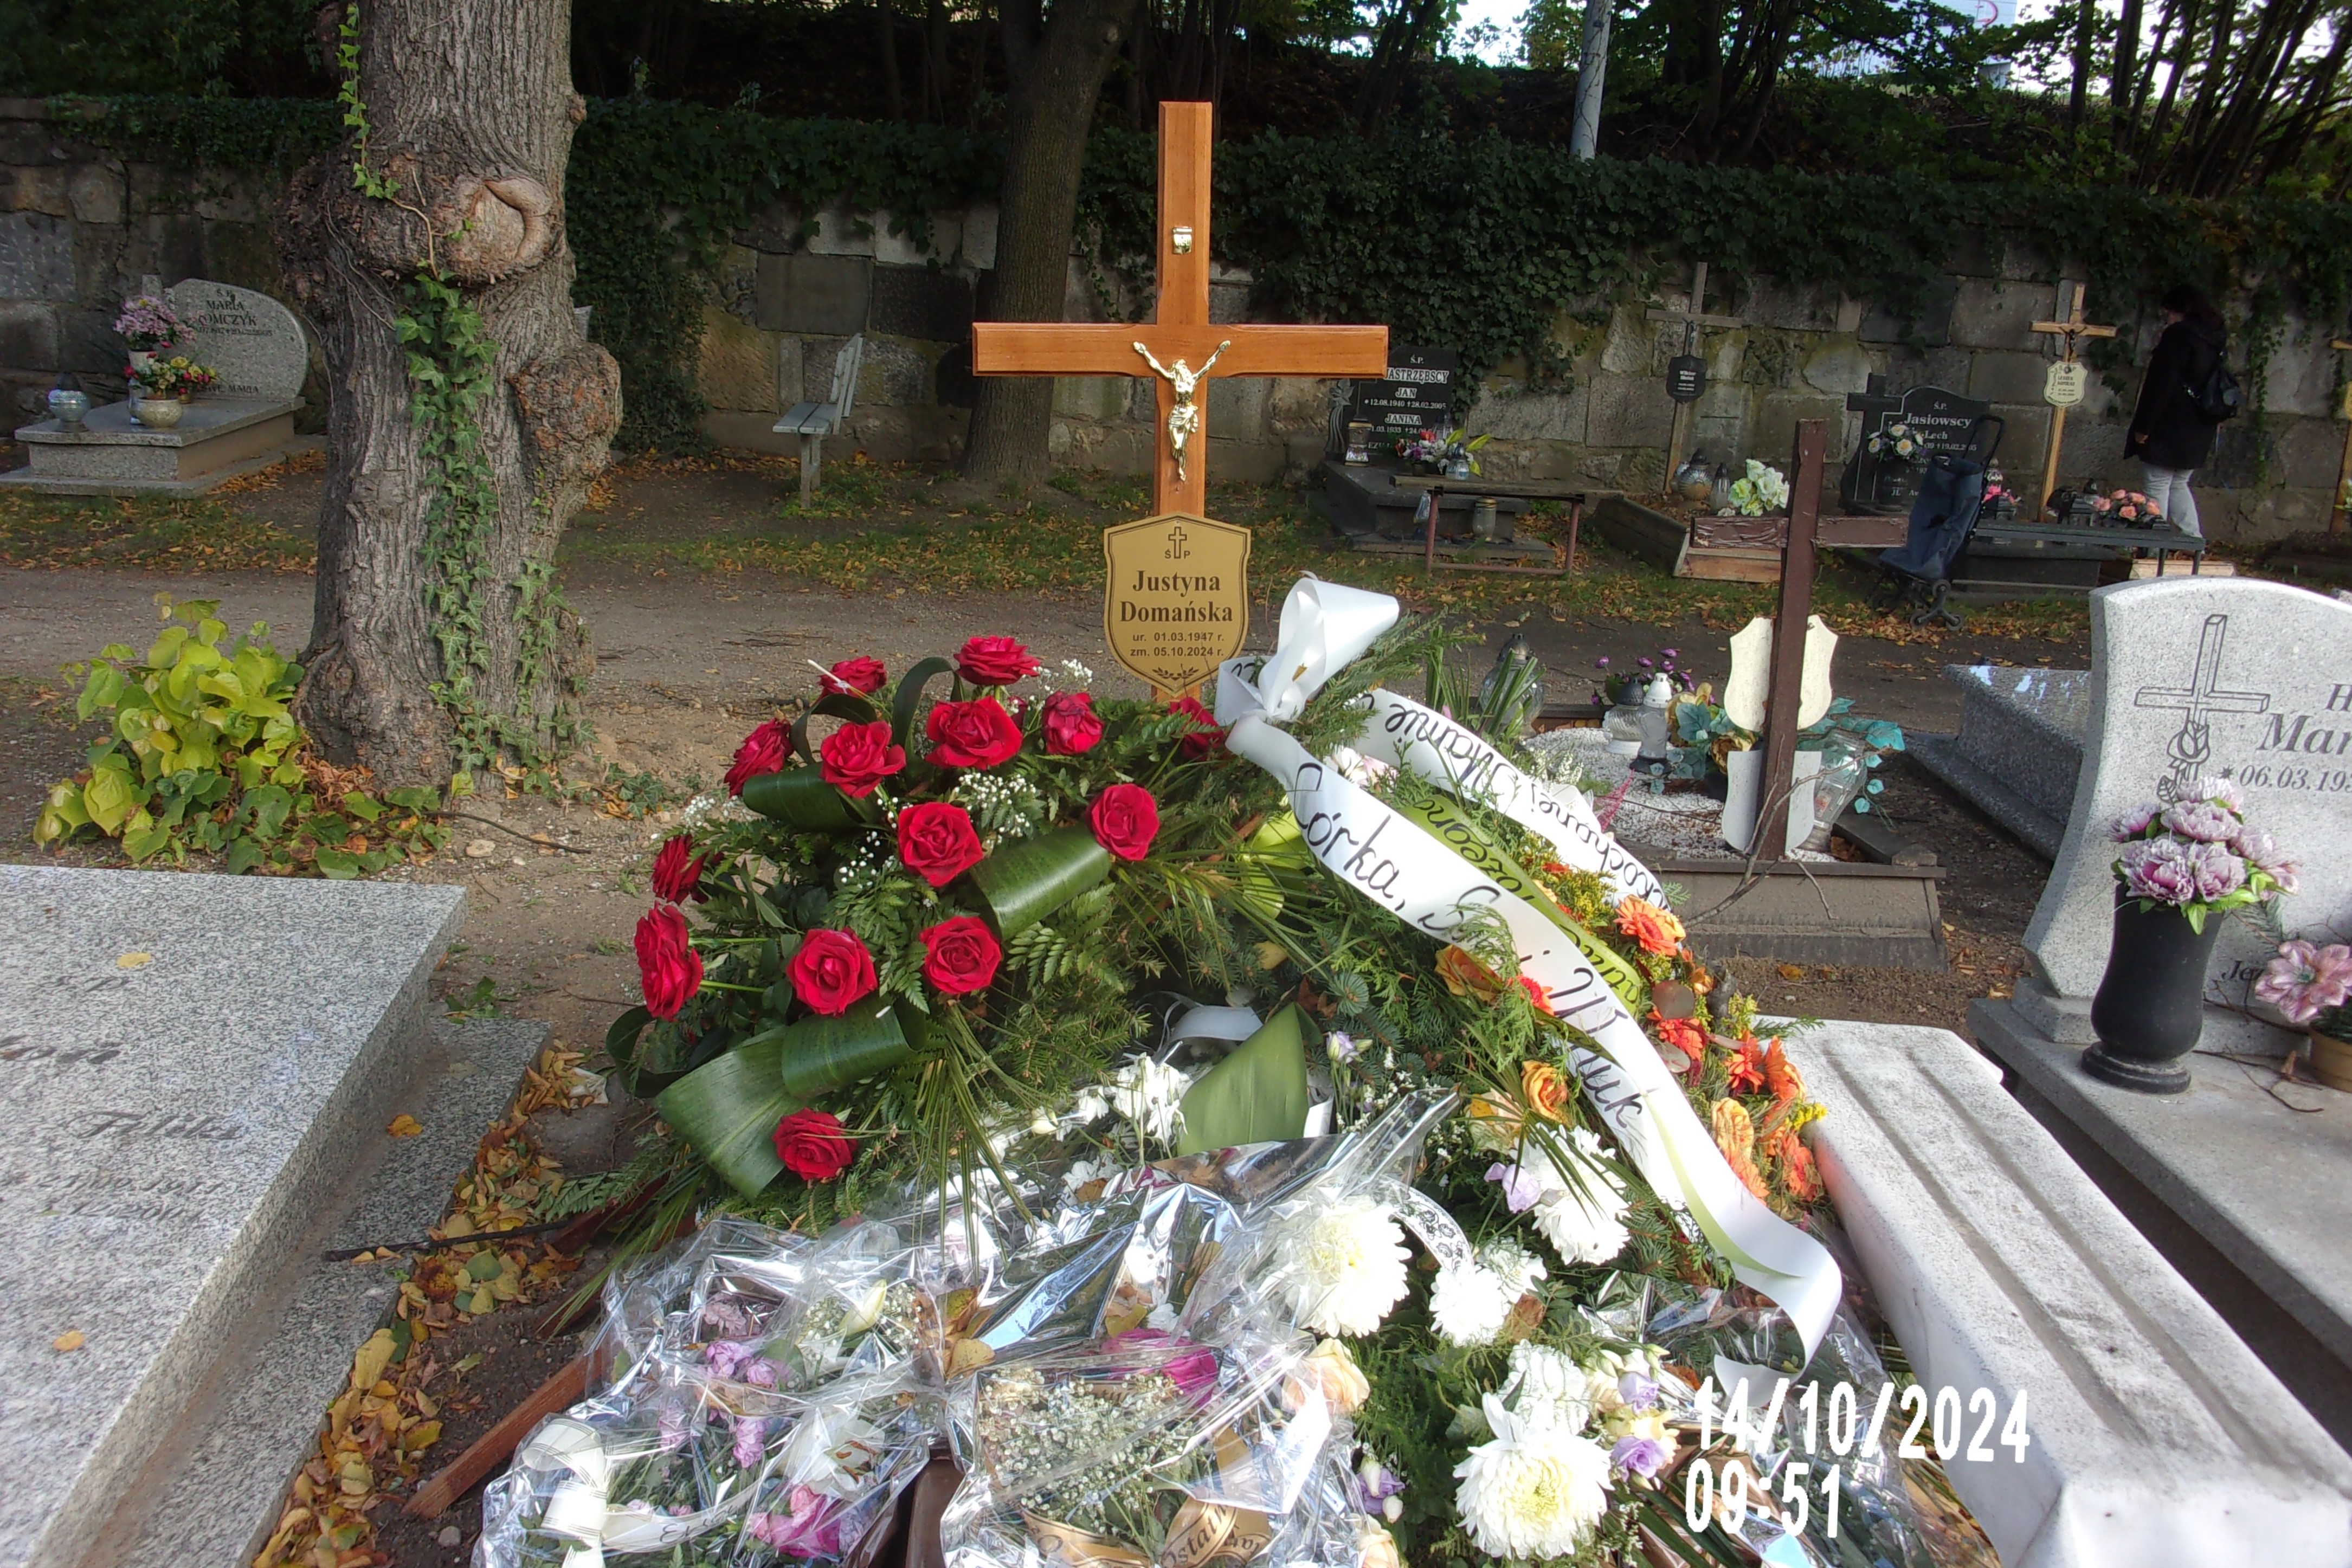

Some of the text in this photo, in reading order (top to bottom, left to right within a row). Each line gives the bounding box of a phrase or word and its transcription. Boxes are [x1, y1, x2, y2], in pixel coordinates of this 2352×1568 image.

[199, 313, 256, 326] OMCZYK
[1386, 367, 1449, 384] ASTRZĘBSCY
[1395, 387, 1417, 398] JAN
[1384, 413, 1422, 425] JANINA
[1904, 412, 1972, 429] Jasiowscy
[1925, 430, 1948, 440] Lech
[1164, 549, 1190, 559] Ś P
[1132, 570, 1221, 597] Justyna
[1120, 600, 1233, 622] Domańska
[1133, 632, 1224, 642] ur. 01.03.1947 r.
[1130, 647, 1224, 657] zm. 05.10.2024 r.
